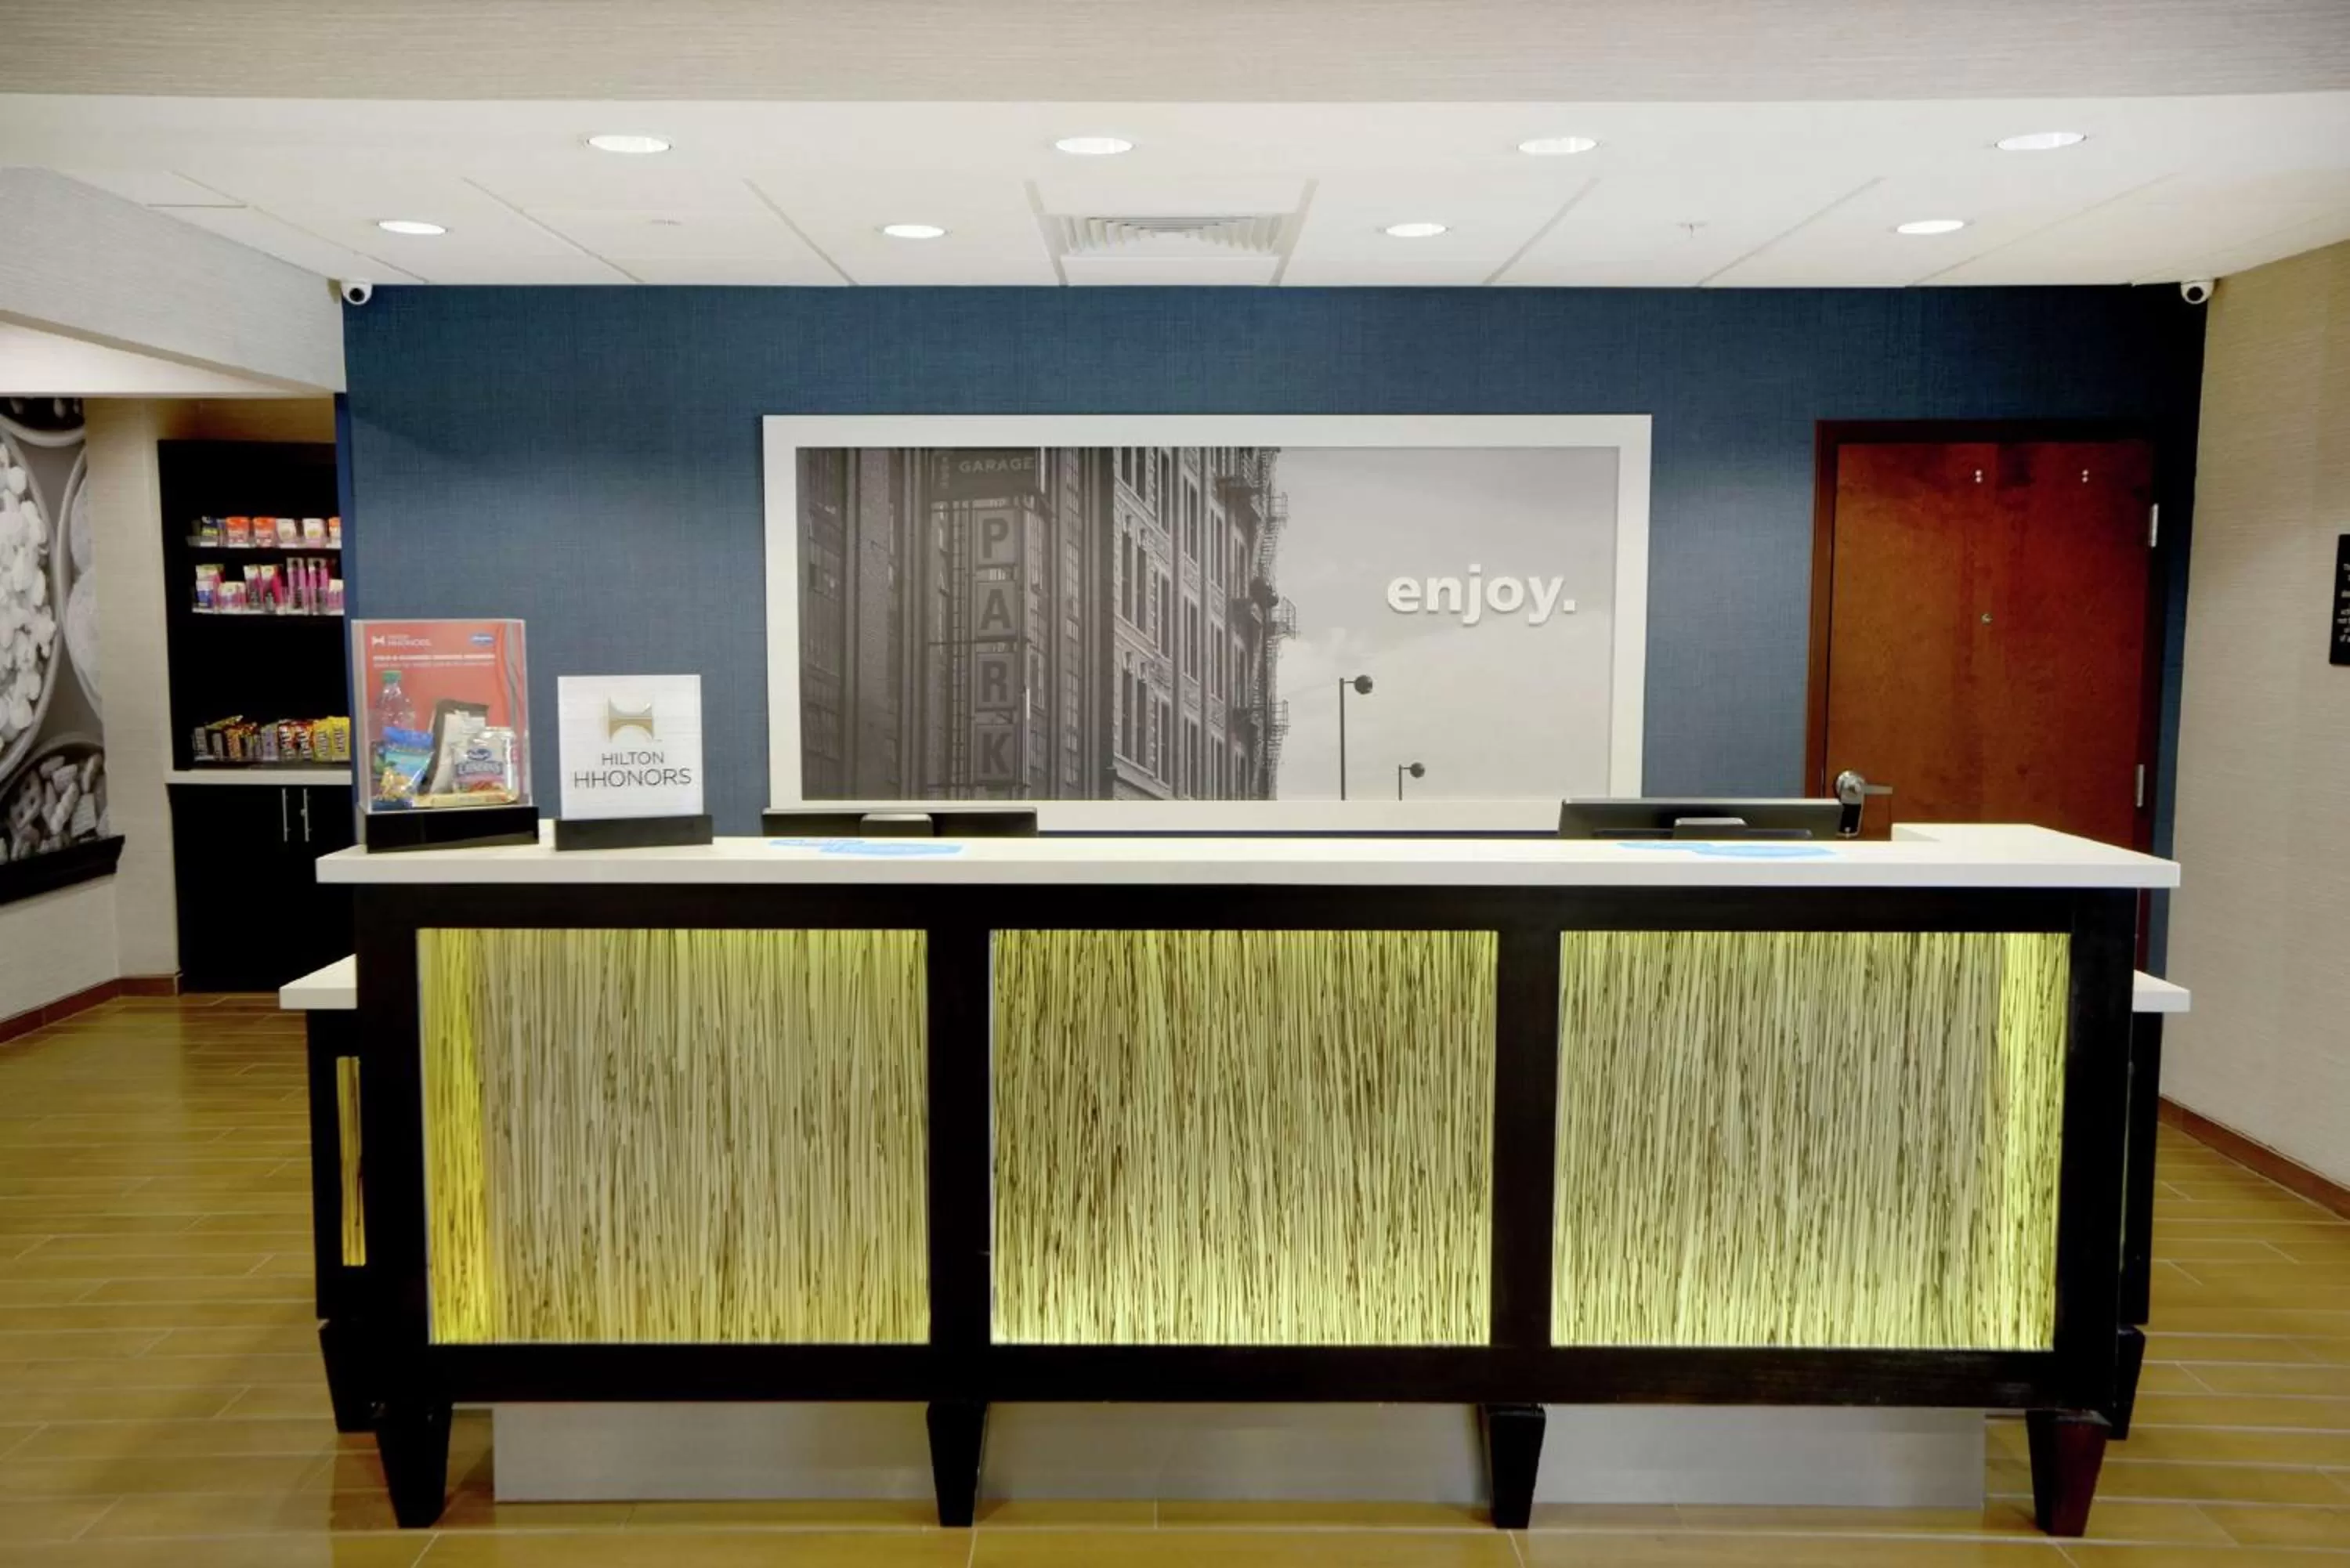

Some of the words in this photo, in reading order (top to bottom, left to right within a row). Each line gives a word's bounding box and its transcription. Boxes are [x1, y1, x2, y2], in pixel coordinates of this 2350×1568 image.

[958, 457, 1035, 474] GARAGE
[1387, 563, 1576, 627] enjoy.
[980, 517, 1013, 775] PARK
[601, 750, 665, 766] HILTON
[573, 768, 692, 789] HHONORS
